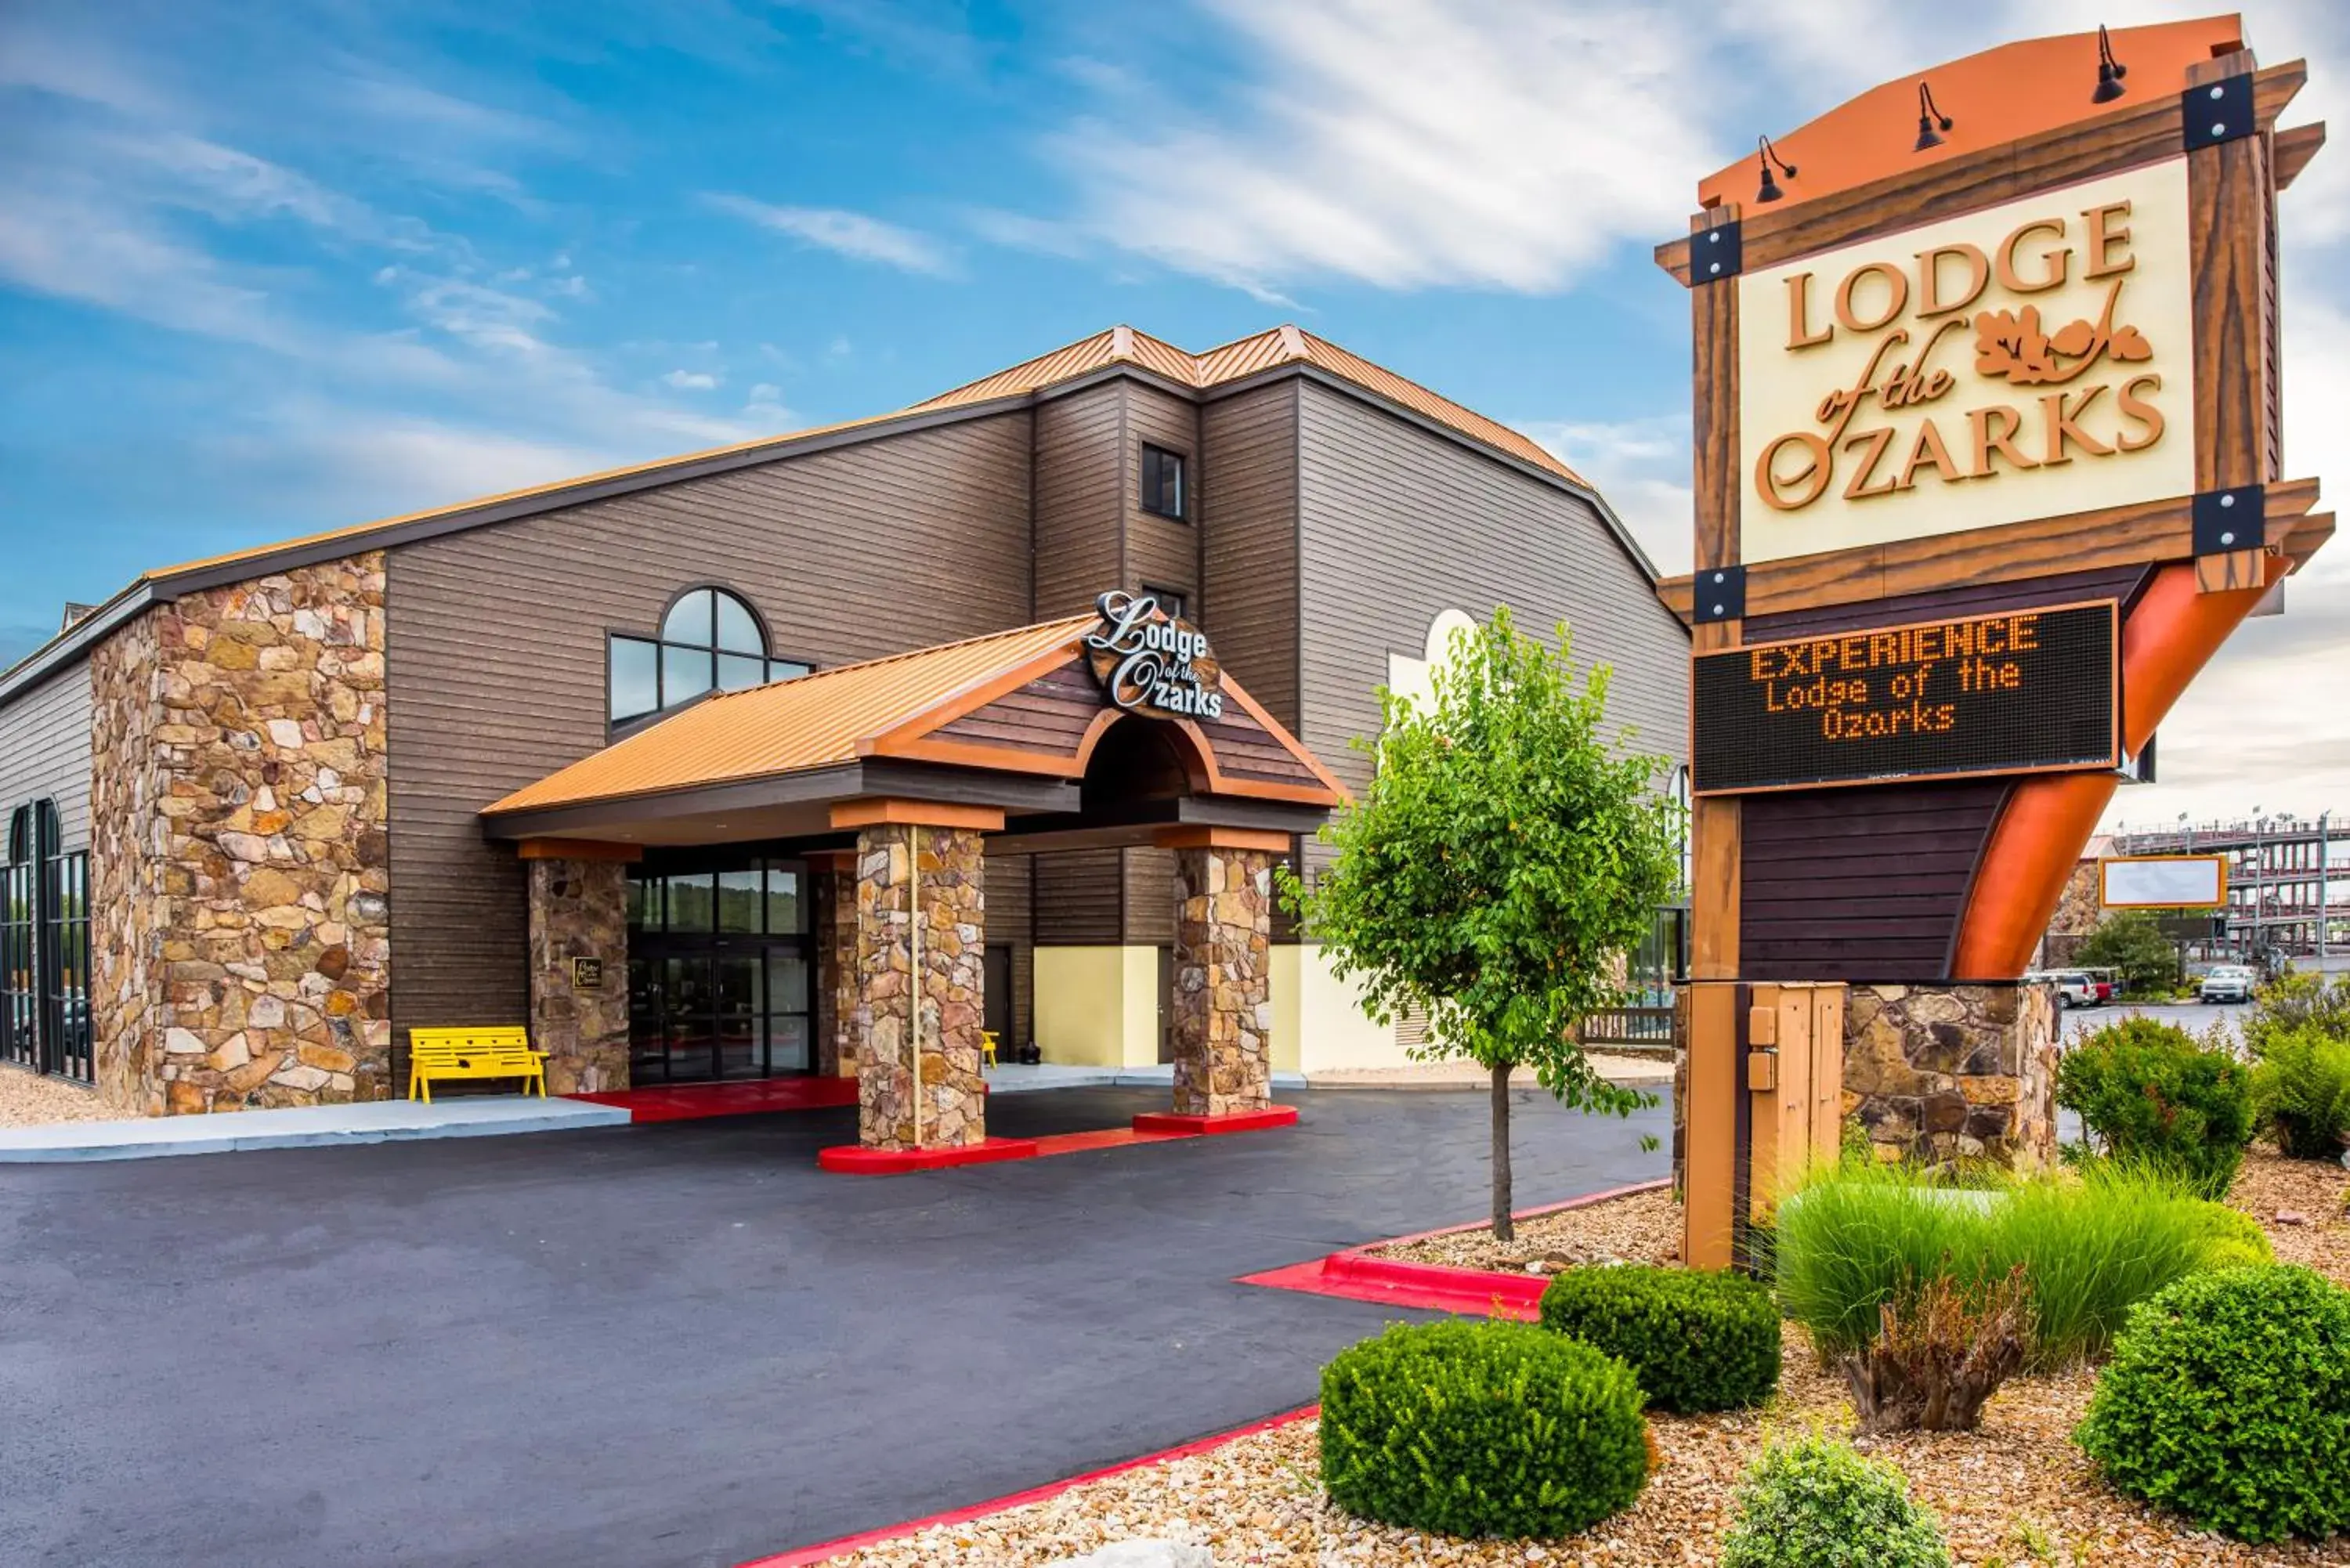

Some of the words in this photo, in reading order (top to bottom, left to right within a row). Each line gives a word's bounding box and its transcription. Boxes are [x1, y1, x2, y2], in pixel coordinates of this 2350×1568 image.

[1783, 199, 2136, 351] LODGE
[1816, 327, 1908, 448] of
[1879, 313, 1970, 410] the
[1755, 373, 2166, 511] OZARKS
[1083, 591, 1207, 663] Lodge
[1751, 614, 2038, 681] EXPERIENCE
[1112, 650, 1222, 718] Ozarks
[1165, 660, 1180, 685] of
[1180, 662, 1201, 681] the
[1768, 675, 1867, 711] Lodge
[1891, 663, 1932, 699] of
[1958, 656, 2019, 692] the
[1824, 699, 1955, 740] Ozarks
